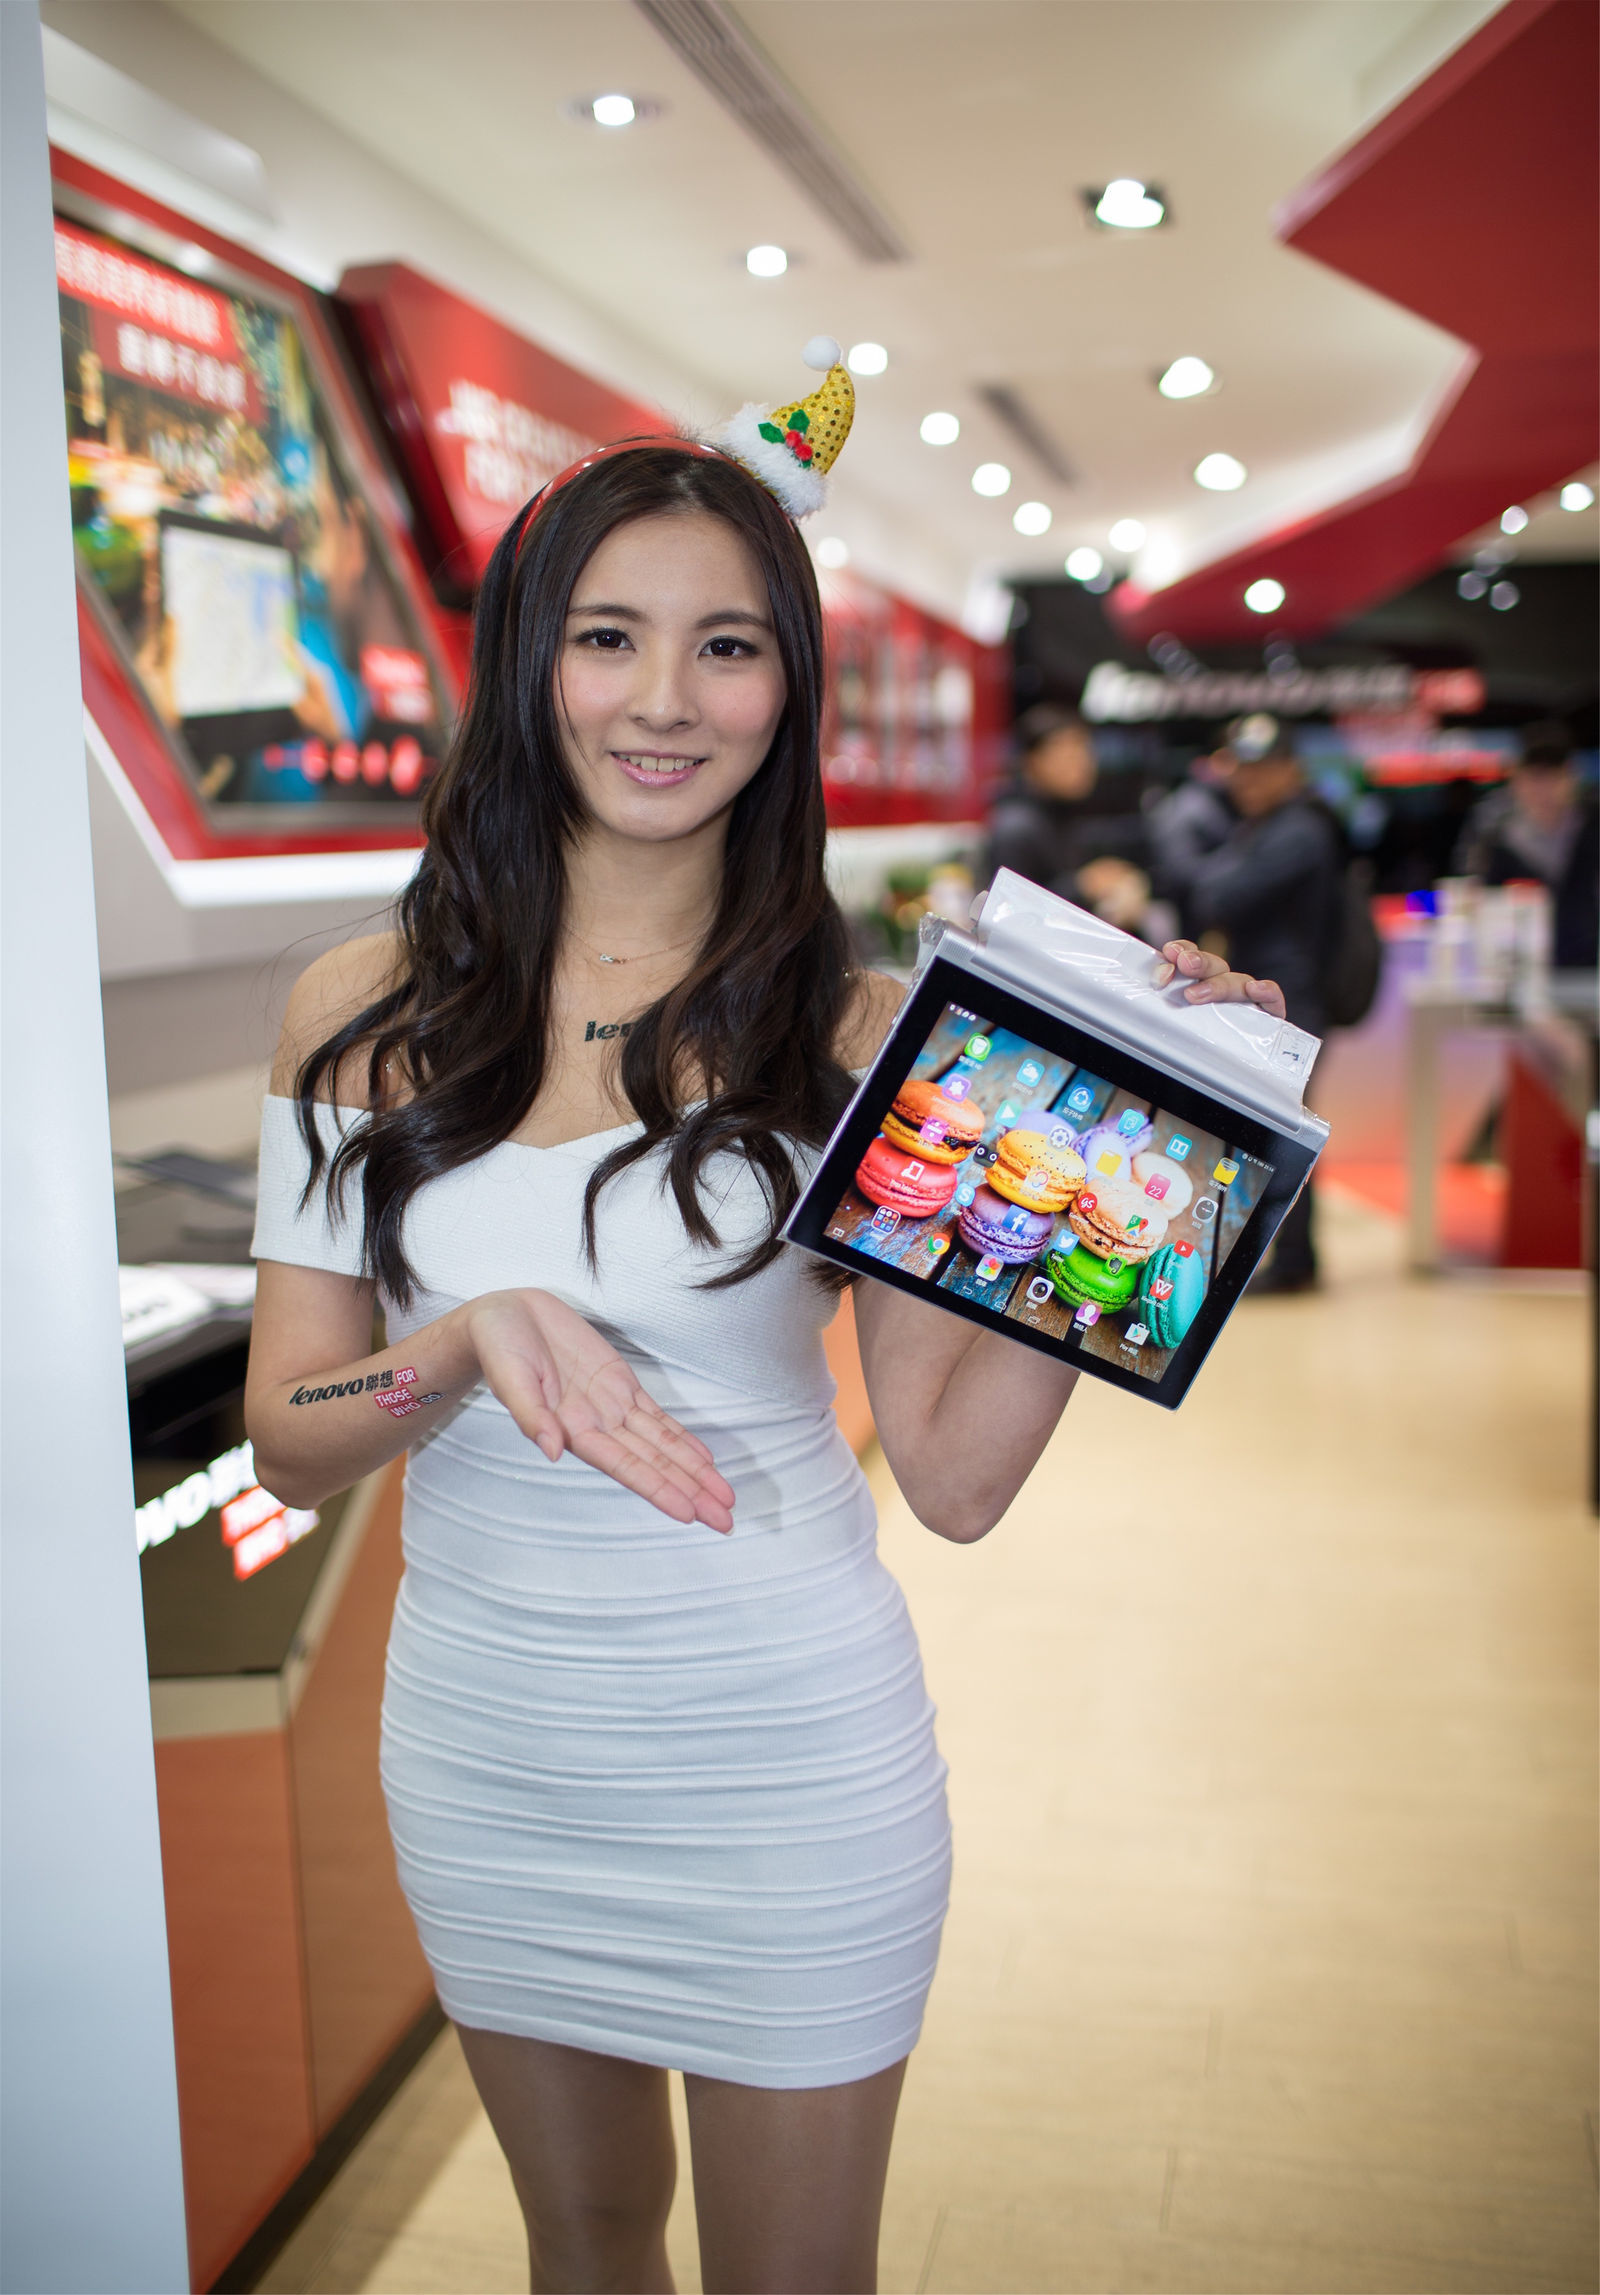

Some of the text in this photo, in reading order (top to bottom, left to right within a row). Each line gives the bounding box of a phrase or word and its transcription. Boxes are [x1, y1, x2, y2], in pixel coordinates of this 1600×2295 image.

[1148, 1185, 1162, 1198] 22
[289, 1369, 416, 1405] lenovo 聯想 FOR
[375, 1388, 413, 1407] THOSE
[390, 1401, 421, 1416] WHO
